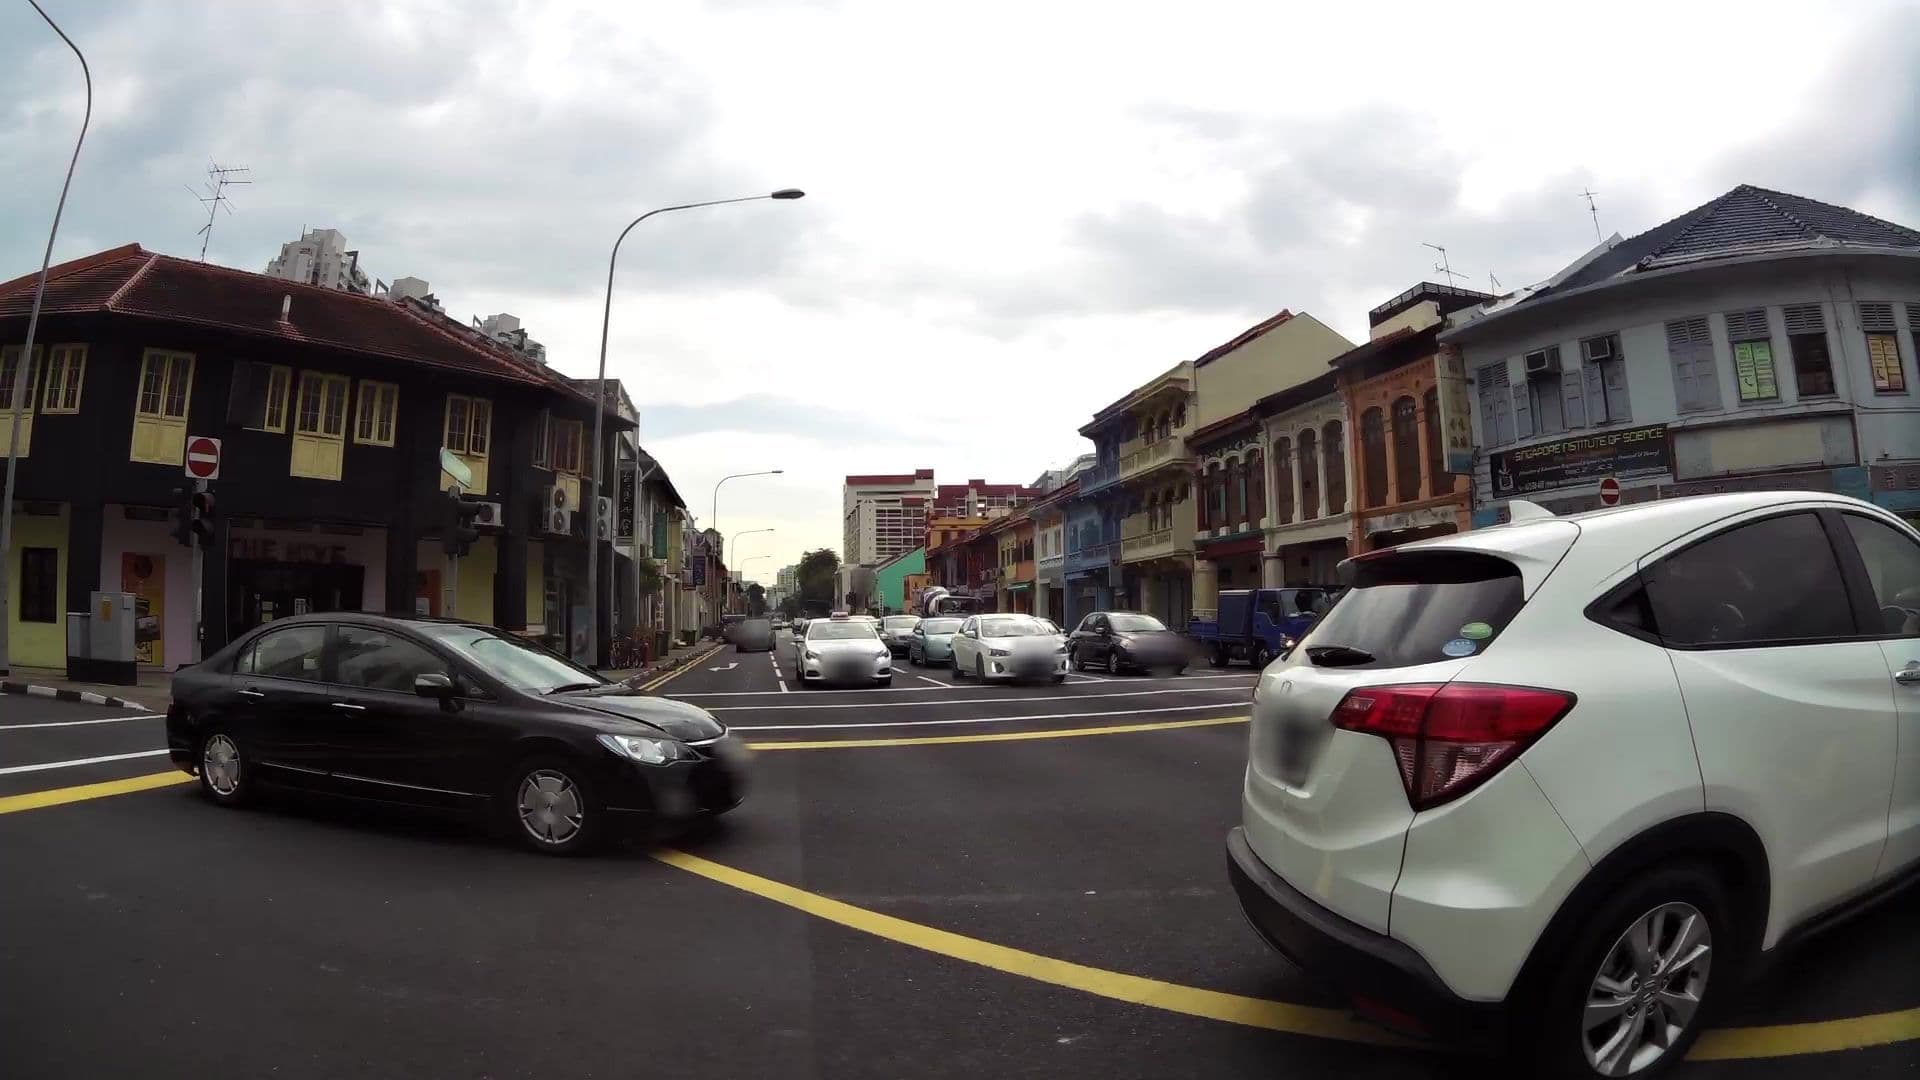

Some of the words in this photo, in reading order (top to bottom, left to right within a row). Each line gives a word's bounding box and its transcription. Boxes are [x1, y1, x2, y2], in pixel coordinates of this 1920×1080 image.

[1514, 443, 1560, 462] SINGAPORE
[1562, 436, 1606, 453] INSTITUTE
[1608, 433, 1622, 445] OF
[1623, 427, 1664, 443] SCIENCE
[231, 537, 278, 561] THE
